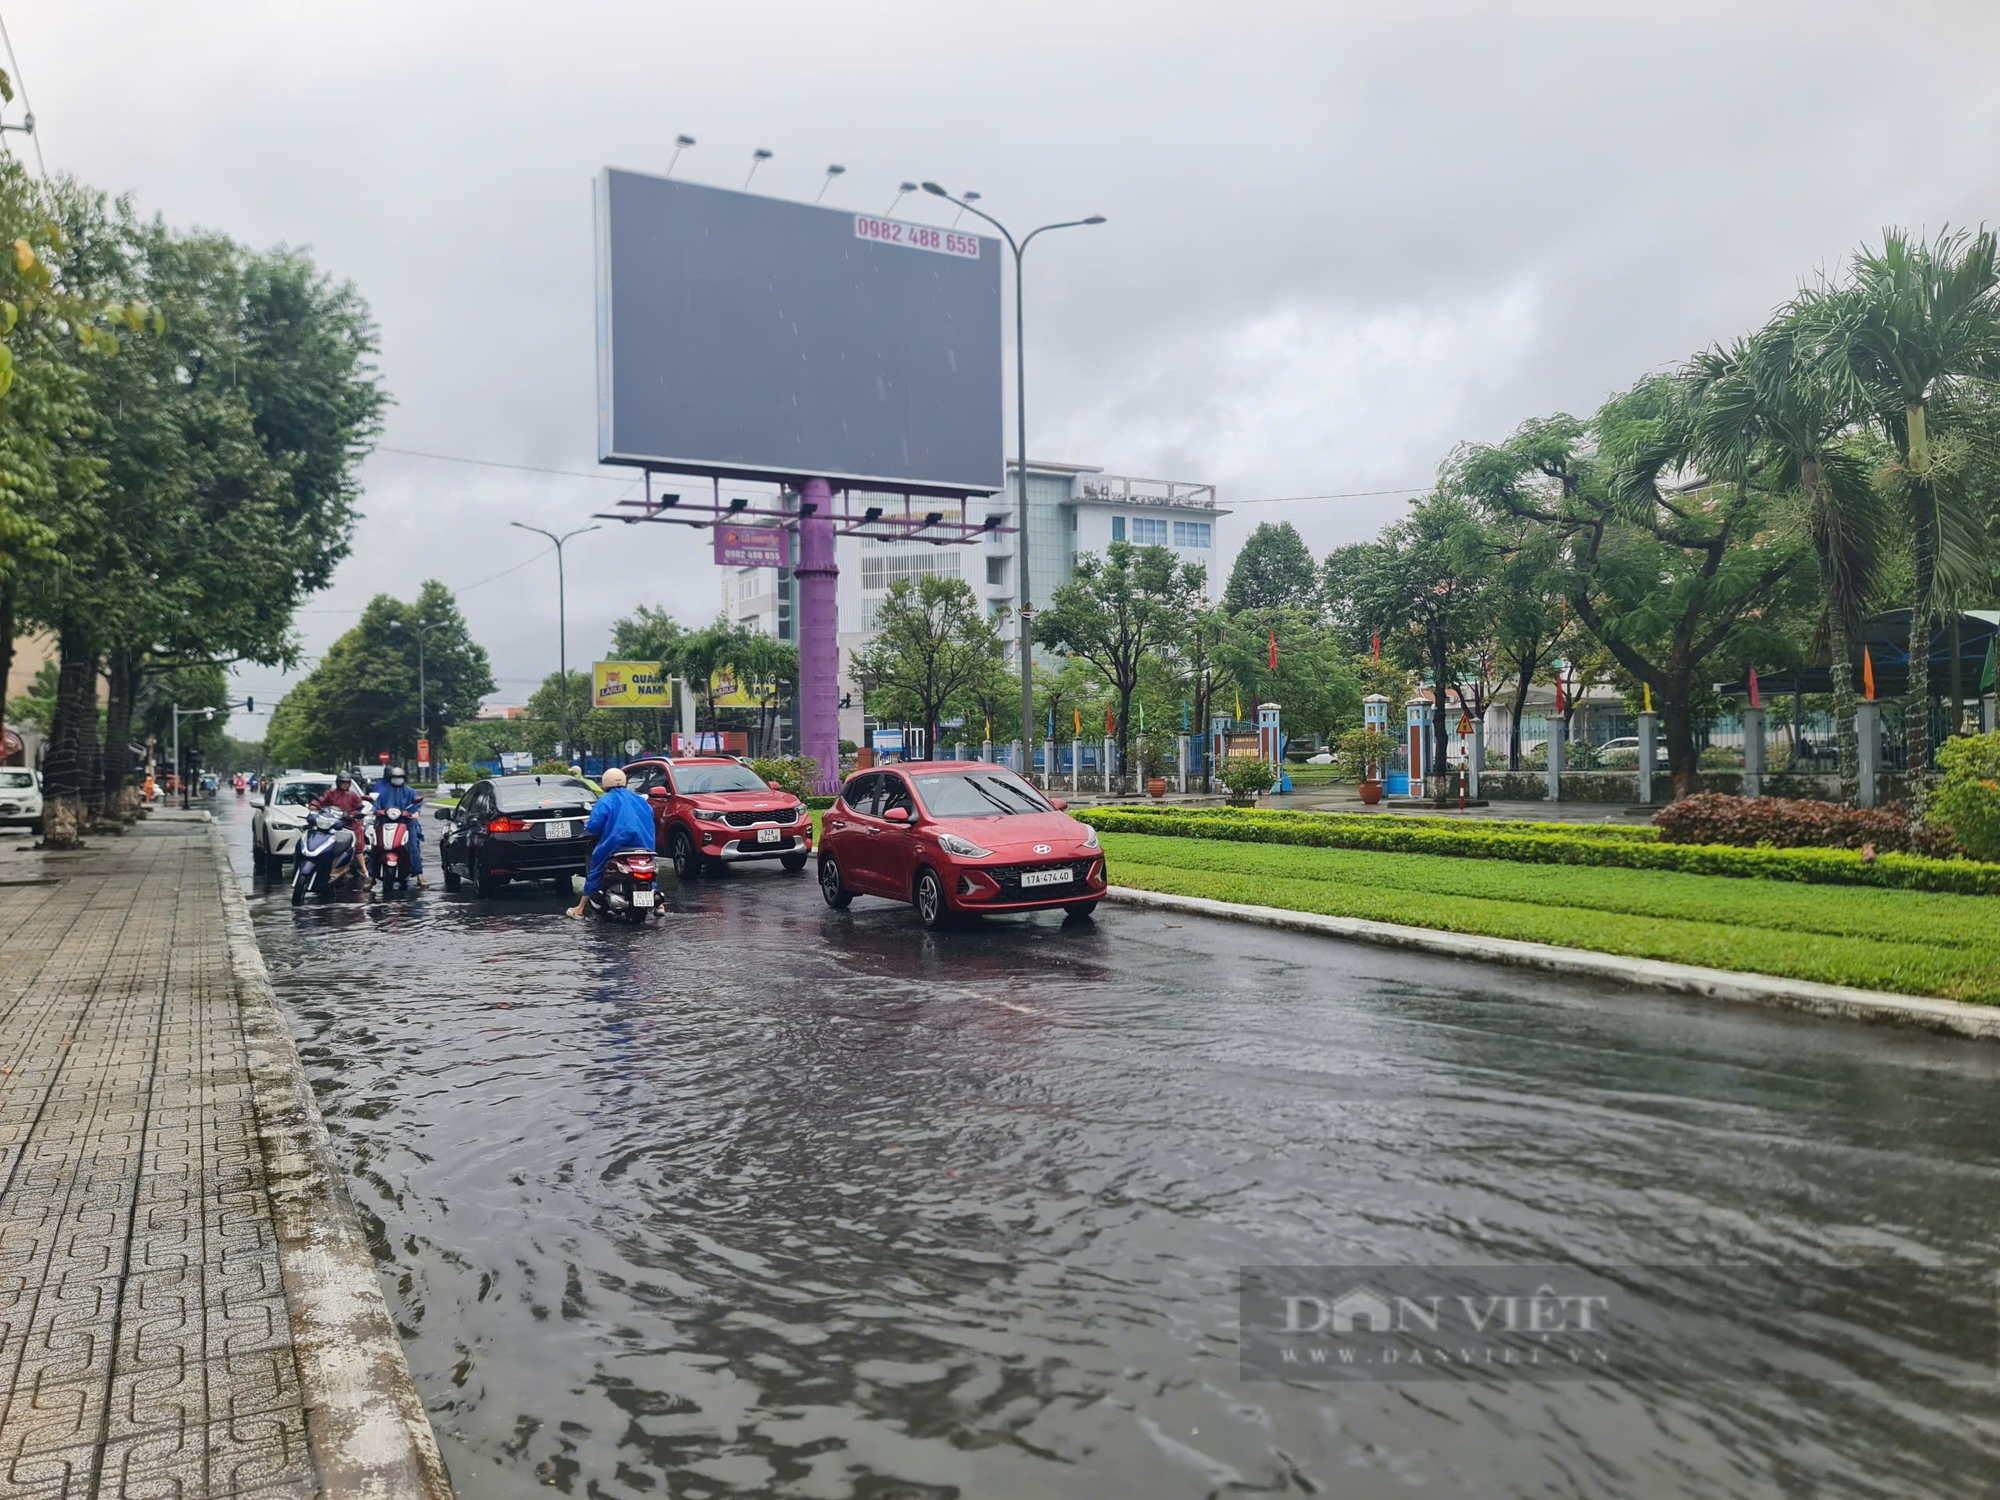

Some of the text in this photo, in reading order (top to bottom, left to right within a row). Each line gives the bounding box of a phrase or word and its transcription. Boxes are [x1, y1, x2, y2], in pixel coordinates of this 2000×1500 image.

[858, 217, 977, 255] 0982 488 655
[725, 549, 780, 561] 0982 488 655
[601, 685, 625, 696] LARUE
[551, 822, 565, 830] 92A
